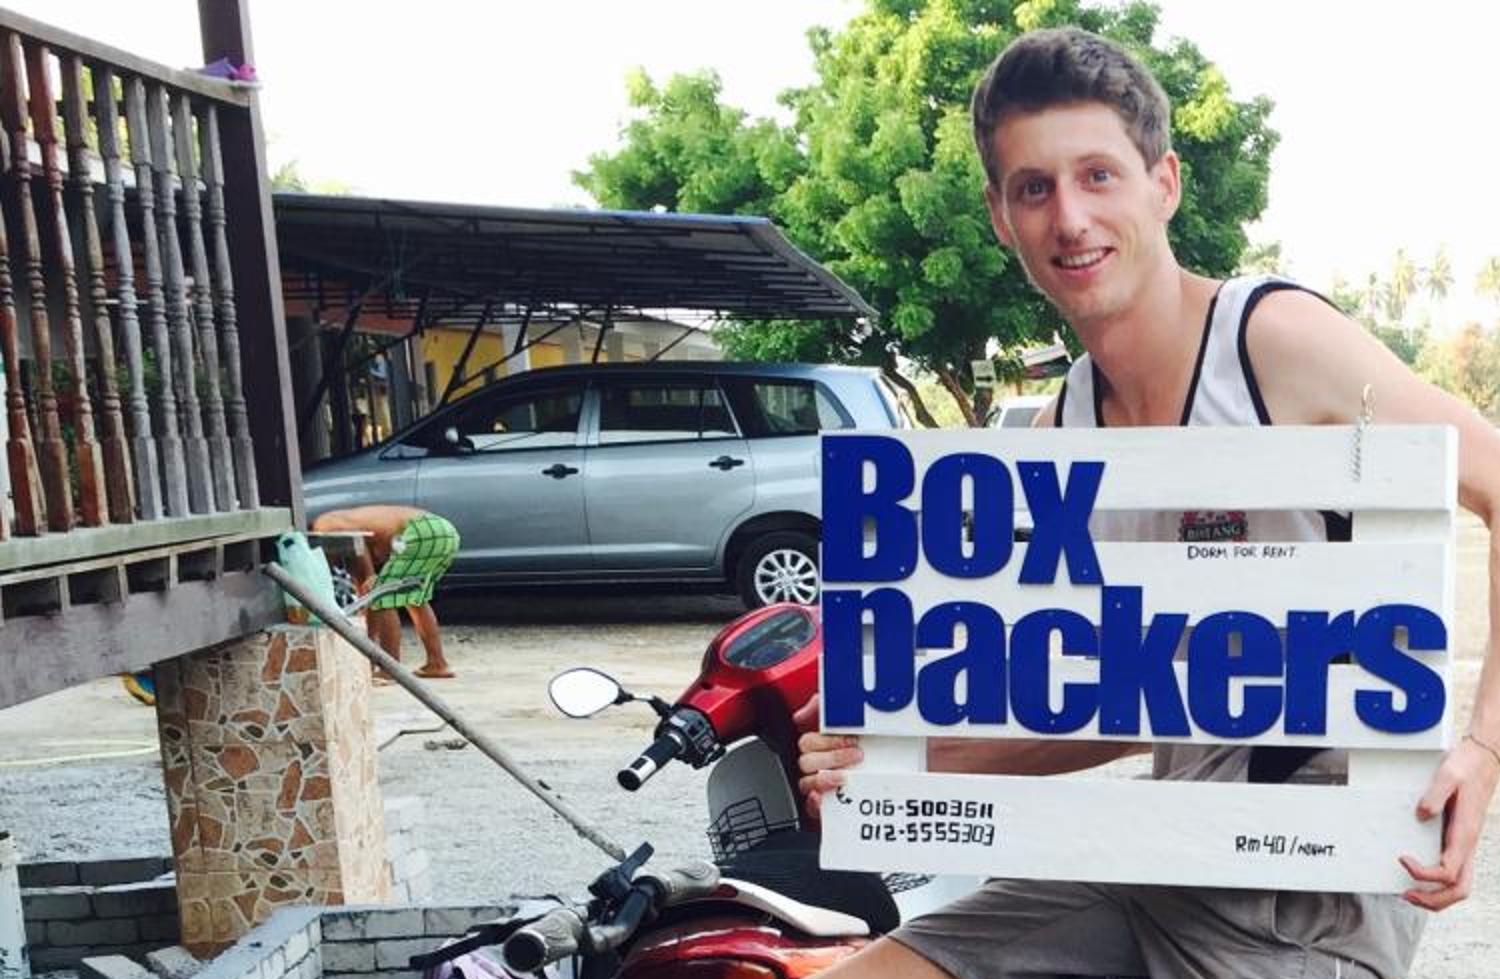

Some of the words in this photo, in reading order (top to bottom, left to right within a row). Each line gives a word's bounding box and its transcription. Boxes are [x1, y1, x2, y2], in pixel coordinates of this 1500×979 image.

[821, 435, 1106, 586] Box
[1233, 545, 1257, 558] FOR
[1263, 545, 1297, 558] RENT
[822, 585, 1448, 738] packers
[859, 799, 994, 819] 016-5003611
[860, 822, 995, 846] 012-5555303
